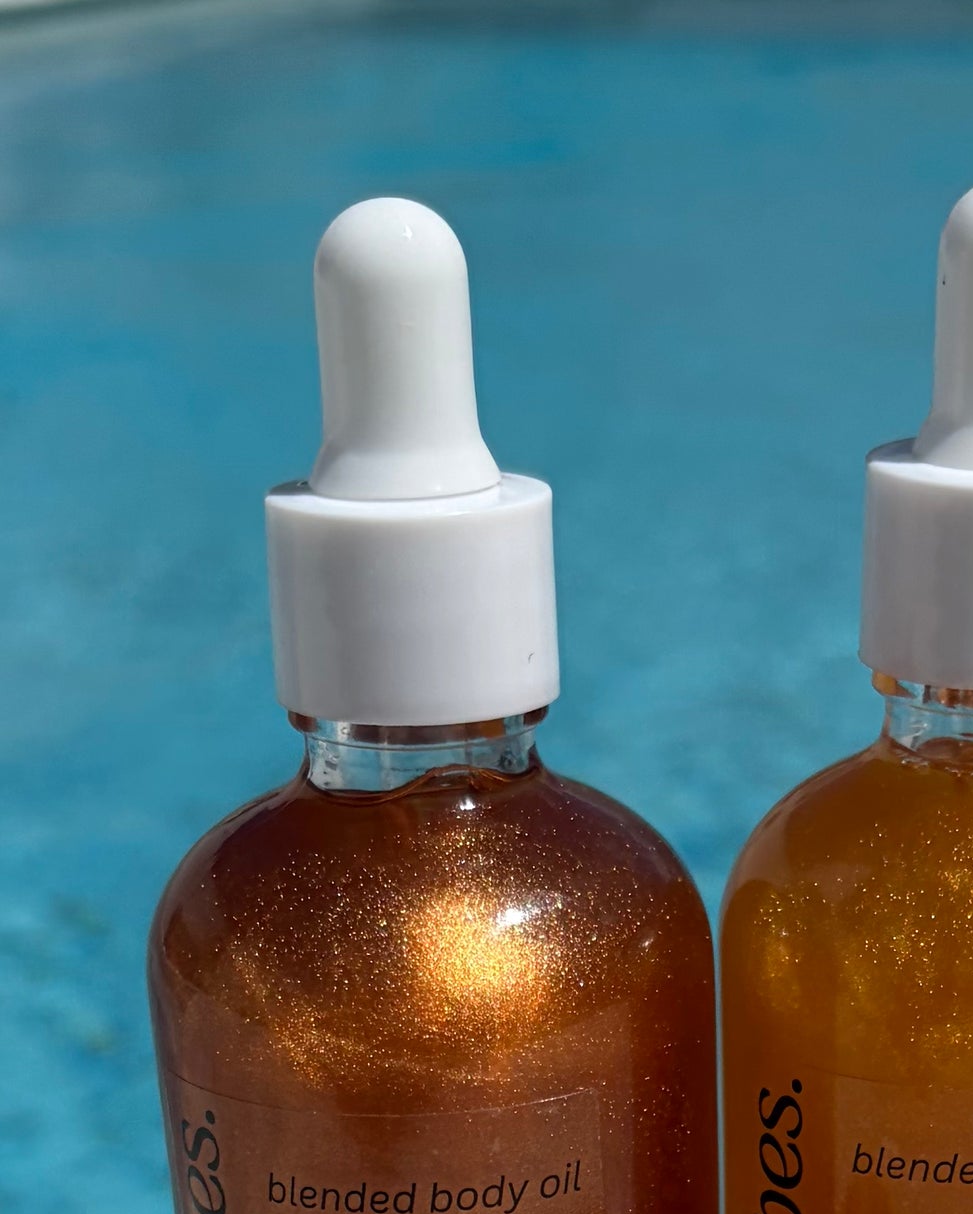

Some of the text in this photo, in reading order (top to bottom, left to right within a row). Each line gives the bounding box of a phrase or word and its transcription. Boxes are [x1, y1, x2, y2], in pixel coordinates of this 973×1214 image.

[267, 1160, 582, 1214] blended body oil
